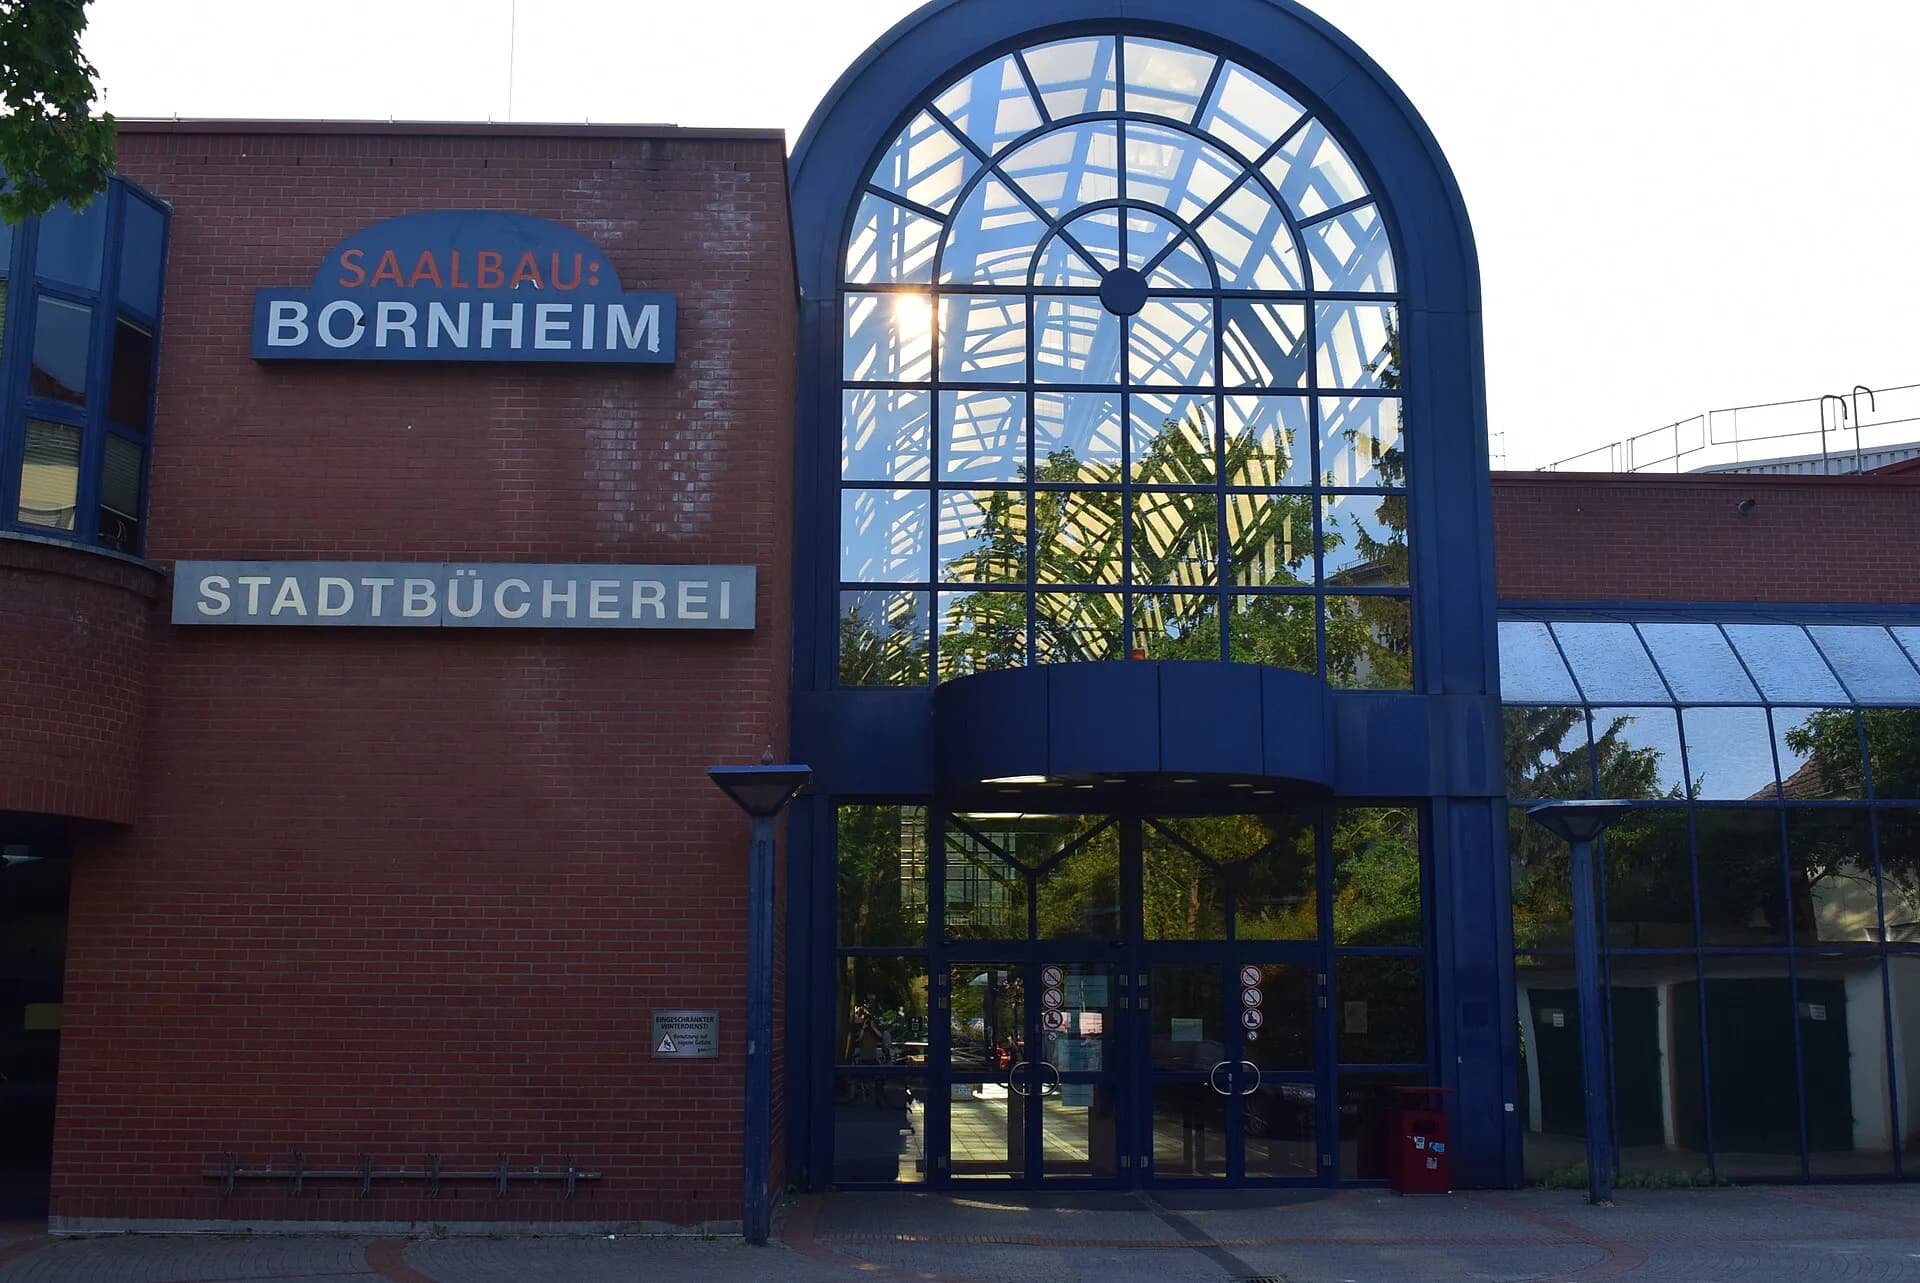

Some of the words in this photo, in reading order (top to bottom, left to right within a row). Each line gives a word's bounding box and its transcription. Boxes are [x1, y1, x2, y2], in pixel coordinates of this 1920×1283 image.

[339, 249, 600, 291] SAALBAU:
[267, 299, 661, 353] BORNHEIM
[197, 569, 731, 620] STADTBÜCHEREI
[655, 1015, 715, 1023] EINGESCHRÄNKTER
